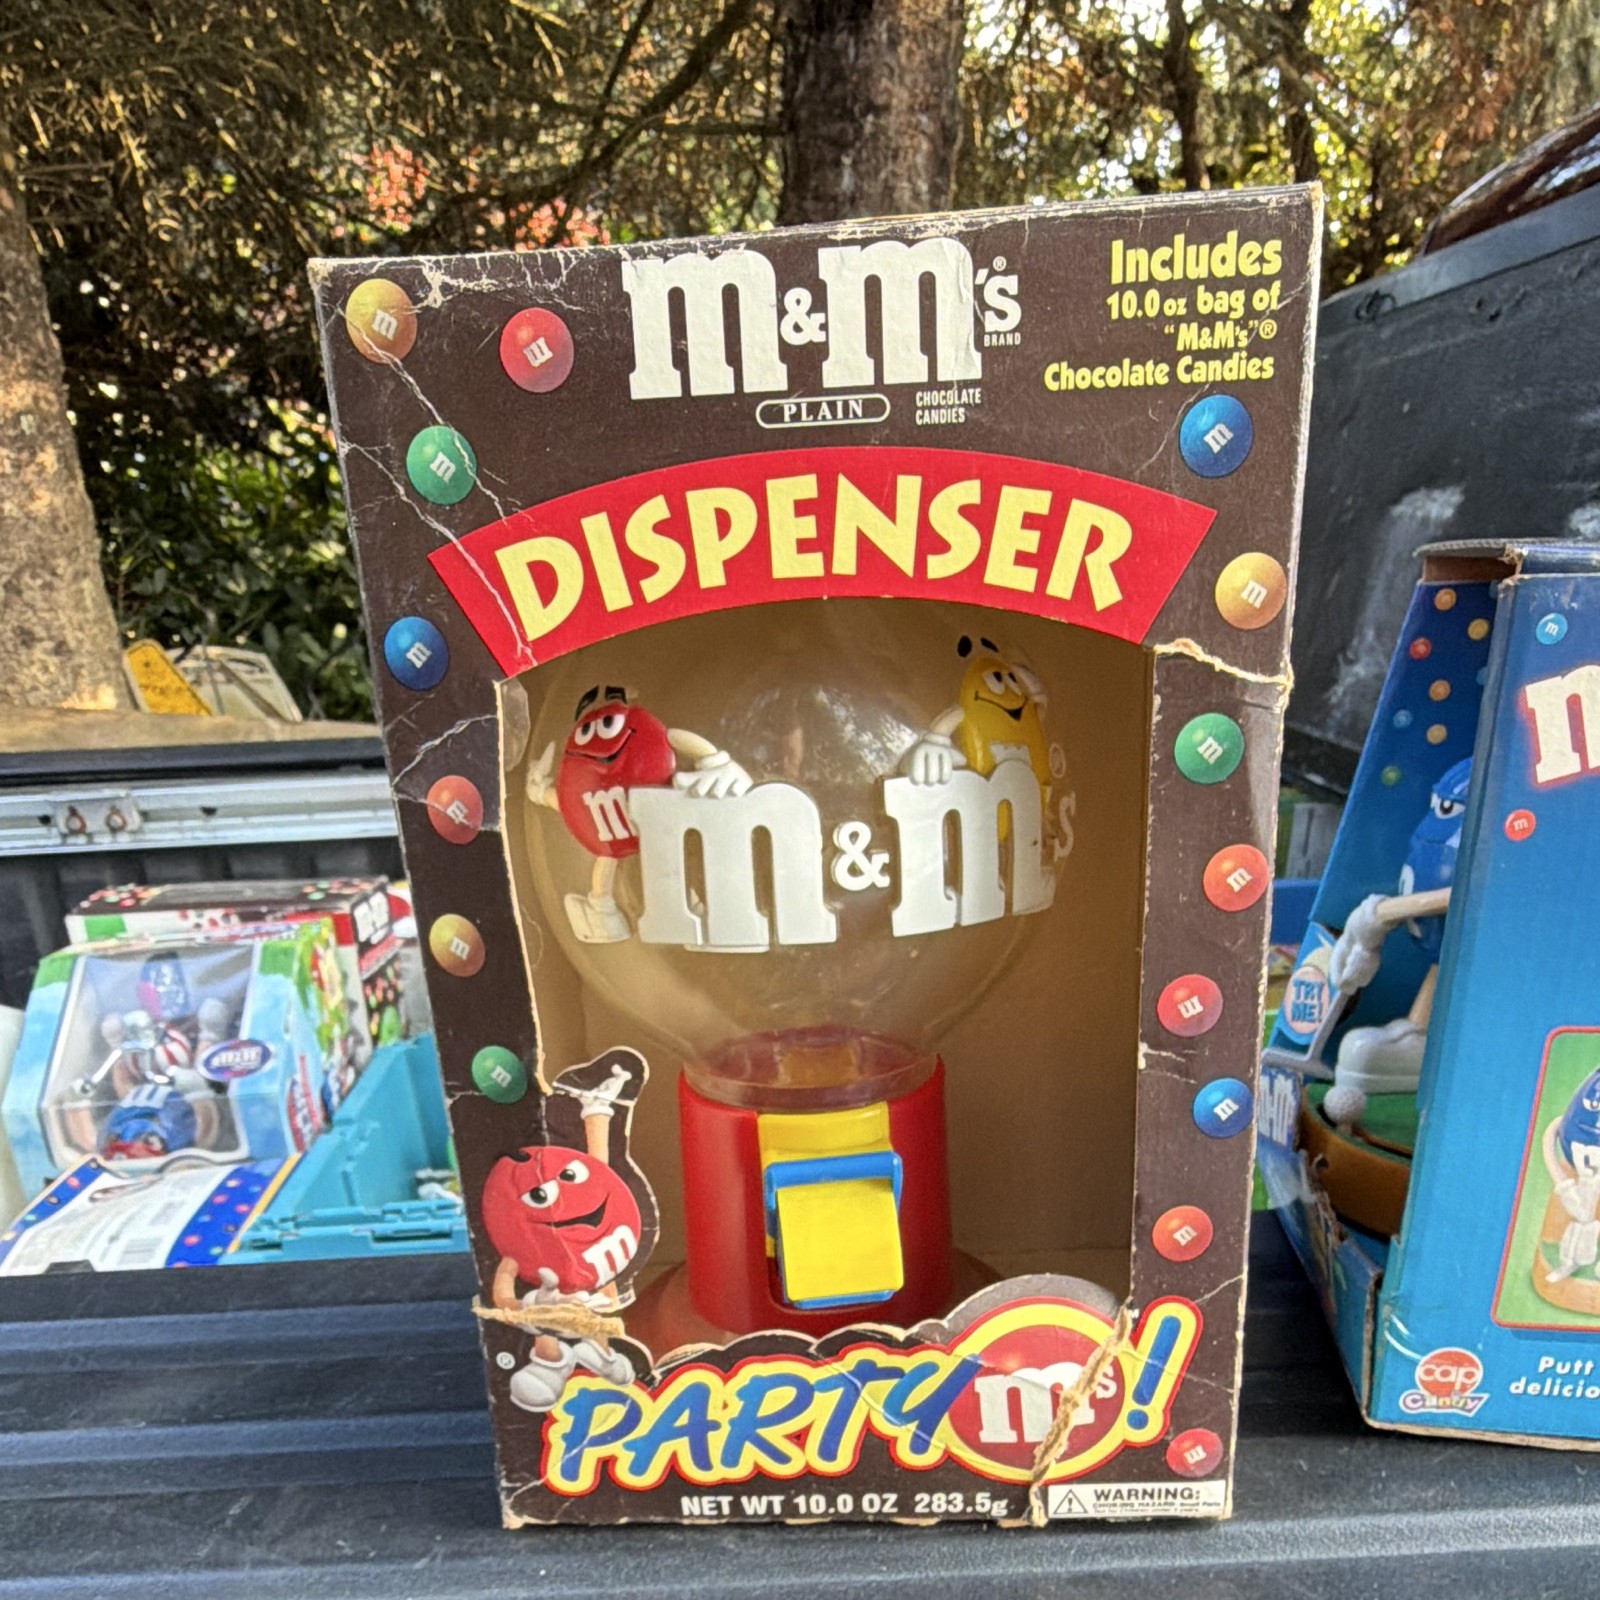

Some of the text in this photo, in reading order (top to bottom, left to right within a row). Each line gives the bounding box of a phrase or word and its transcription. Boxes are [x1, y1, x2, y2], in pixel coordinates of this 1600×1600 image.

[1111, 230, 1282, 284] Includes
[1106, 280, 1281, 319] 10.0 oz bag of
[983, 332, 1021, 347] BRAND
[1044, 350, 1274, 391] Chocolate Candies
[916, 388, 981, 407] CHOCOLATE
[783, 399, 863, 422] PLAIN
[916, 407, 965, 425] CANDIES
[495, 473, 1133, 642] DISPENSER
[1292, 979, 1323, 1001] TRY
[1290, 1002, 1322, 1023] ME!
[1419, 1364, 1480, 1391] cap
[1538, 1356, 1594, 1376] Putt
[560, 1353, 984, 1484] PARTY
[680, 1492, 1008, 1517] NET WT 10.0 OZ 283.5g
[1093, 1486, 1201, 1501] WARNING:
